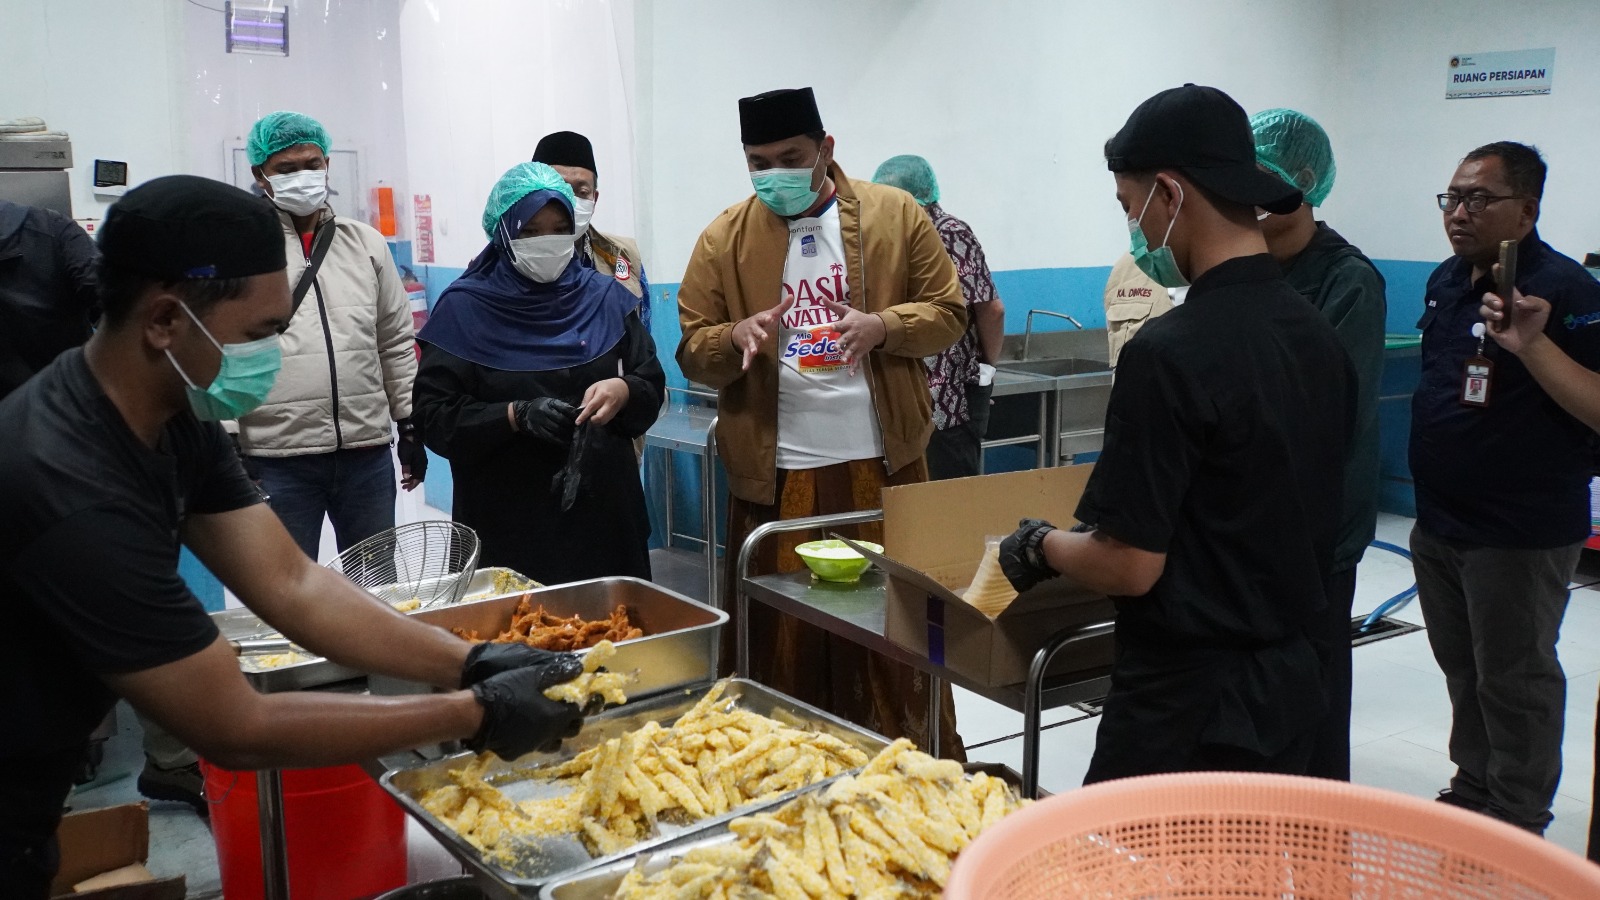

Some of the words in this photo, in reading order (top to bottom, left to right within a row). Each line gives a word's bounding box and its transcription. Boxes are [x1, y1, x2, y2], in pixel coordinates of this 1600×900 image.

[1453, 72, 1487, 83] RUANG
[1489, 69, 1546, 81] PERSIAPAN
[791, 225, 823, 234] antfarm
[781, 307, 841, 329] WATE
[795, 332, 812, 340] Mie
[784, 337, 844, 358] Seda
